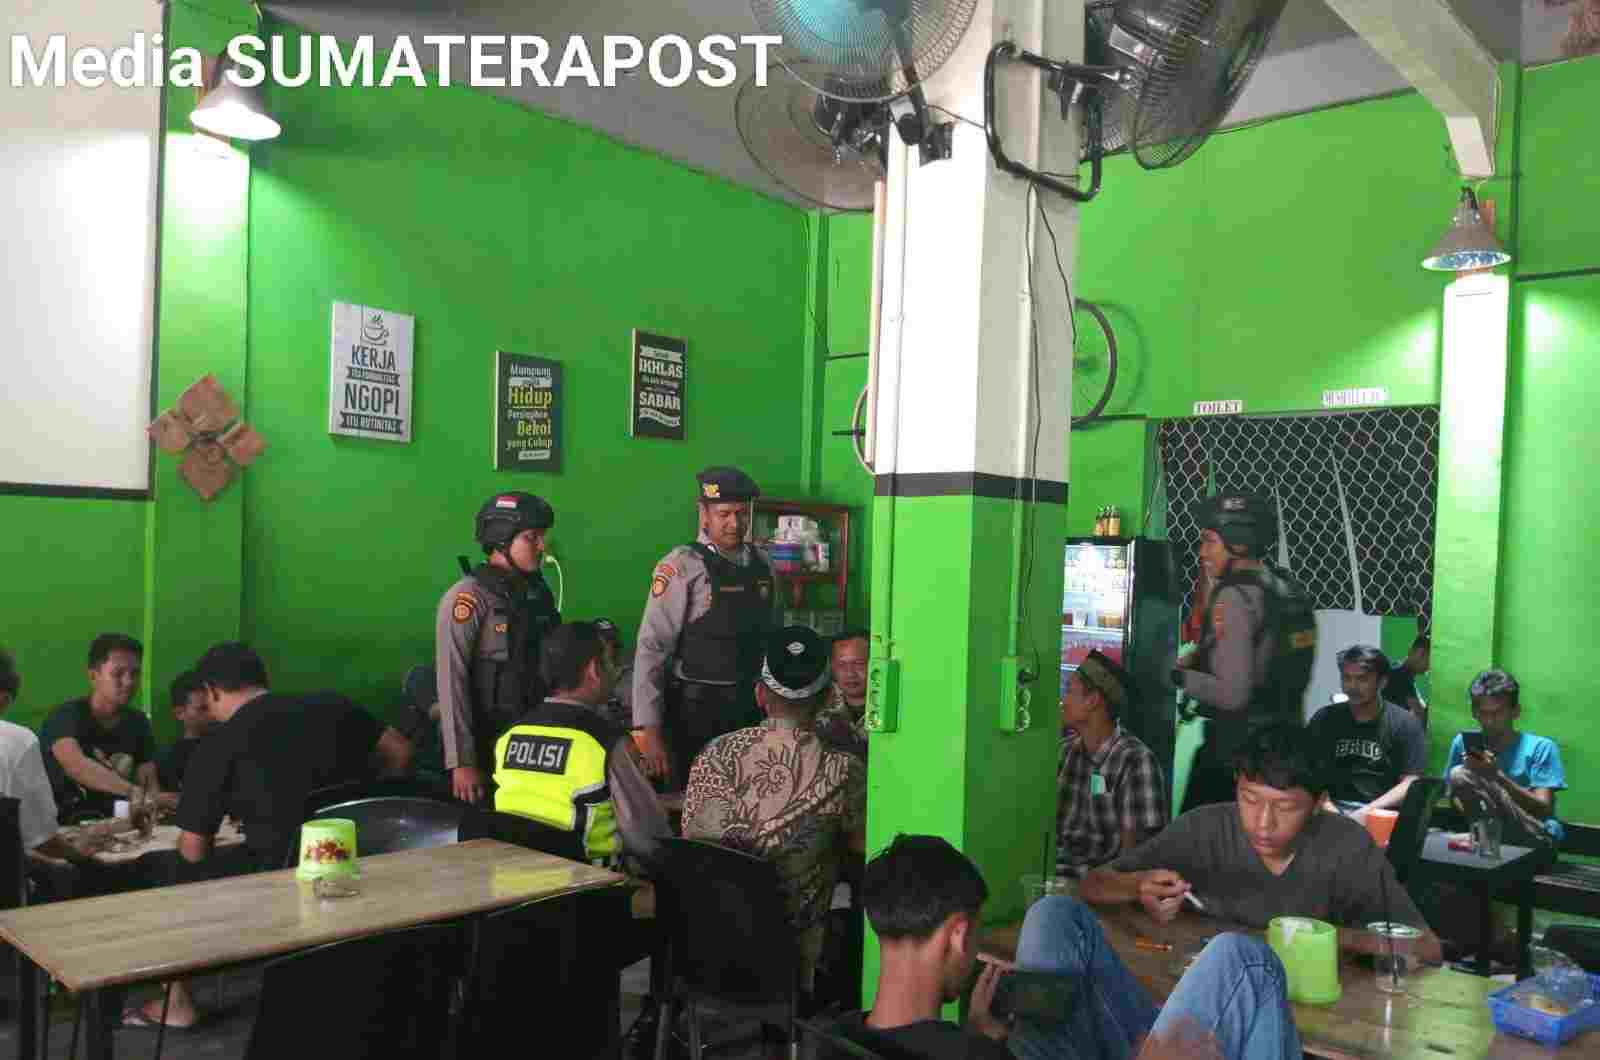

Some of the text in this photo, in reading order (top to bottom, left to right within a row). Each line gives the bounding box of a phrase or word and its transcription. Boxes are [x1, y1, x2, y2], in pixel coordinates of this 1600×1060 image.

[351, 343, 396, 372] KERJA
[344, 382, 399, 416] NGOPI
[508, 384, 552, 410] Hidup
[639, 391, 681, 410] SABAR
[506, 741, 565, 768] POLISI
